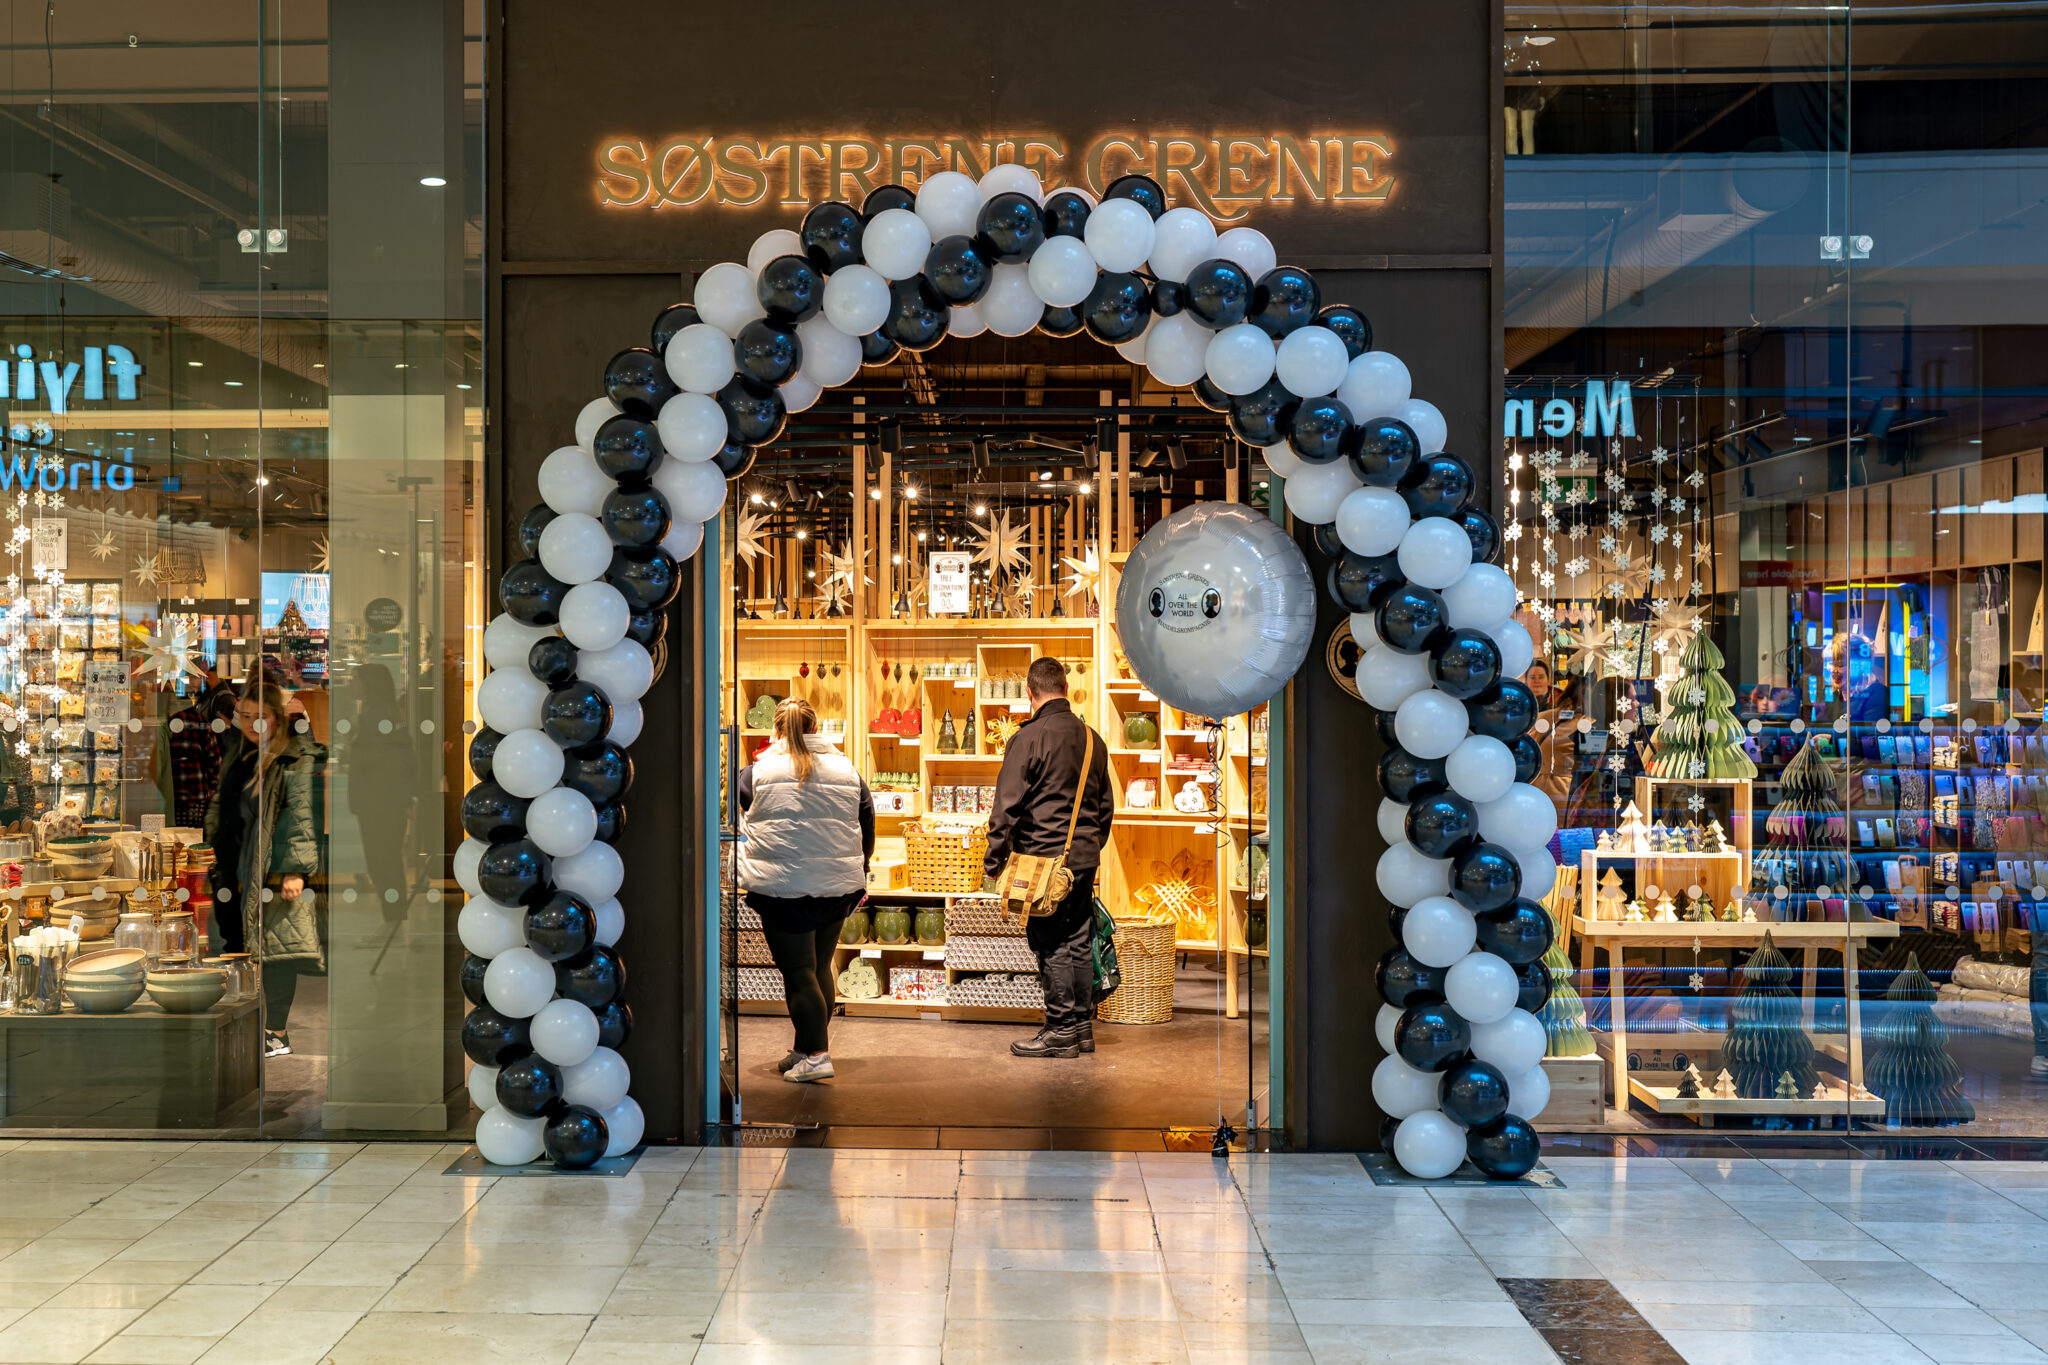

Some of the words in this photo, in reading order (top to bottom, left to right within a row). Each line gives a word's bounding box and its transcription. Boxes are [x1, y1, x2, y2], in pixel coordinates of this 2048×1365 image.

[597, 136, 1067, 208] SØSTRENE
[1087, 135, 1396, 221] GRENE
[0, 449, 134, 492] World
[1168, 601, 1185, 609] OVER
[1187, 601, 1198, 609] THE
